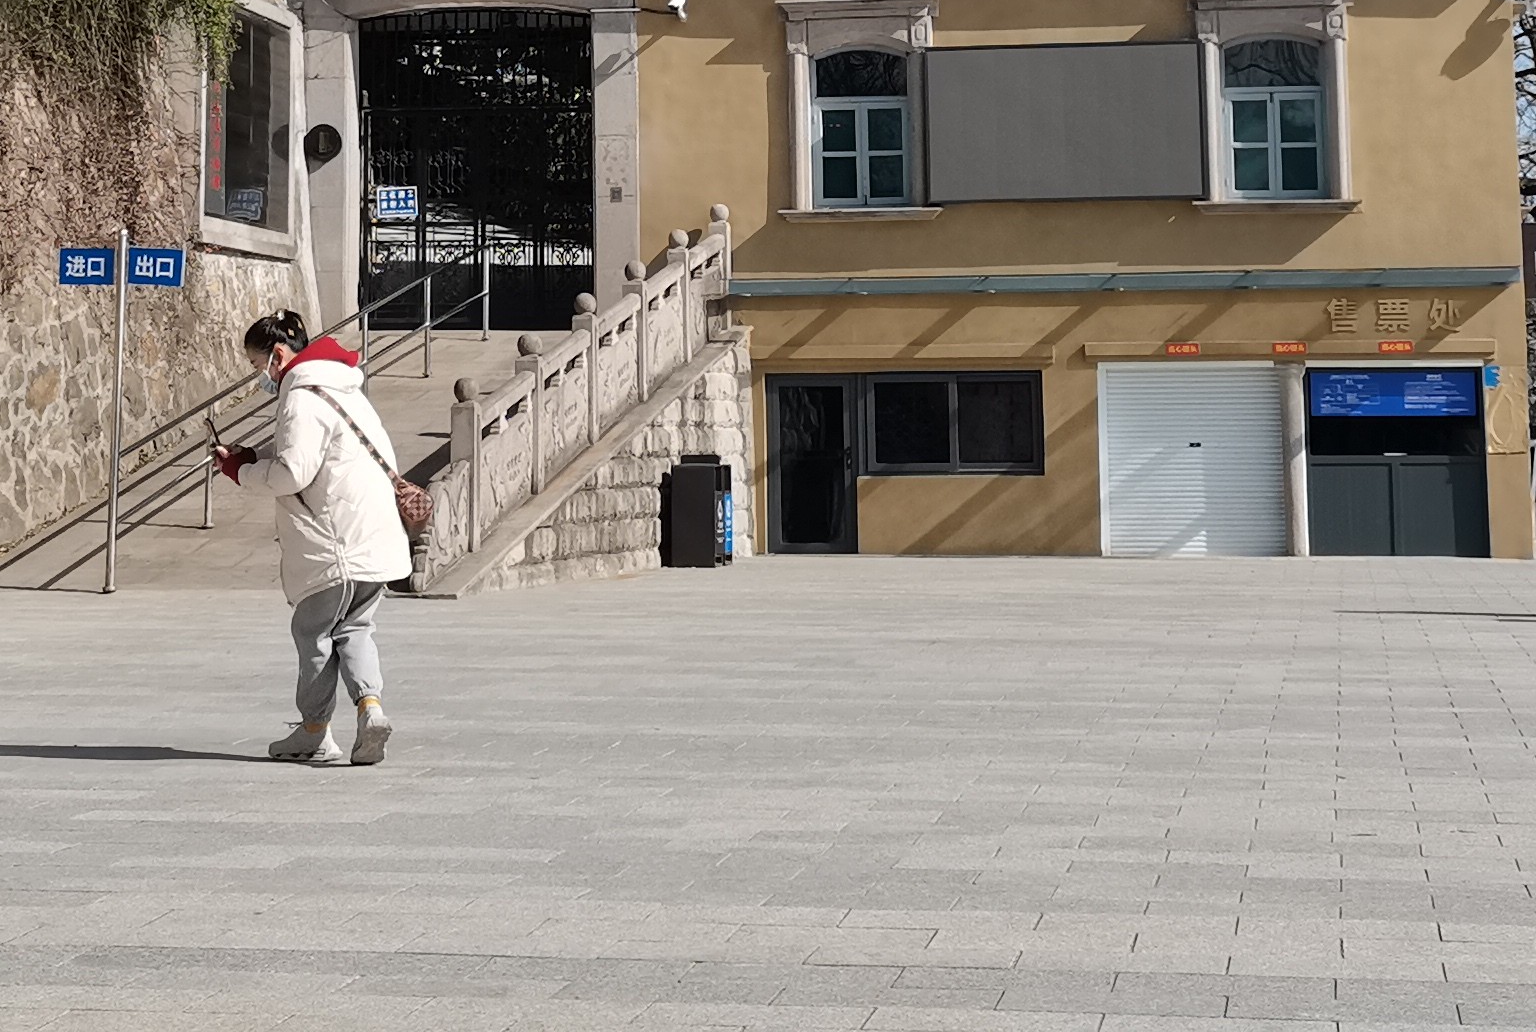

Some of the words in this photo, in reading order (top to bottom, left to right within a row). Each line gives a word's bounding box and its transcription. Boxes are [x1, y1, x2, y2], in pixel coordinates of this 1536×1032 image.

[64, 254, 106, 278] 进口
[134, 255, 176, 279] 出口
[1326, 297, 1463, 333] 售票处
